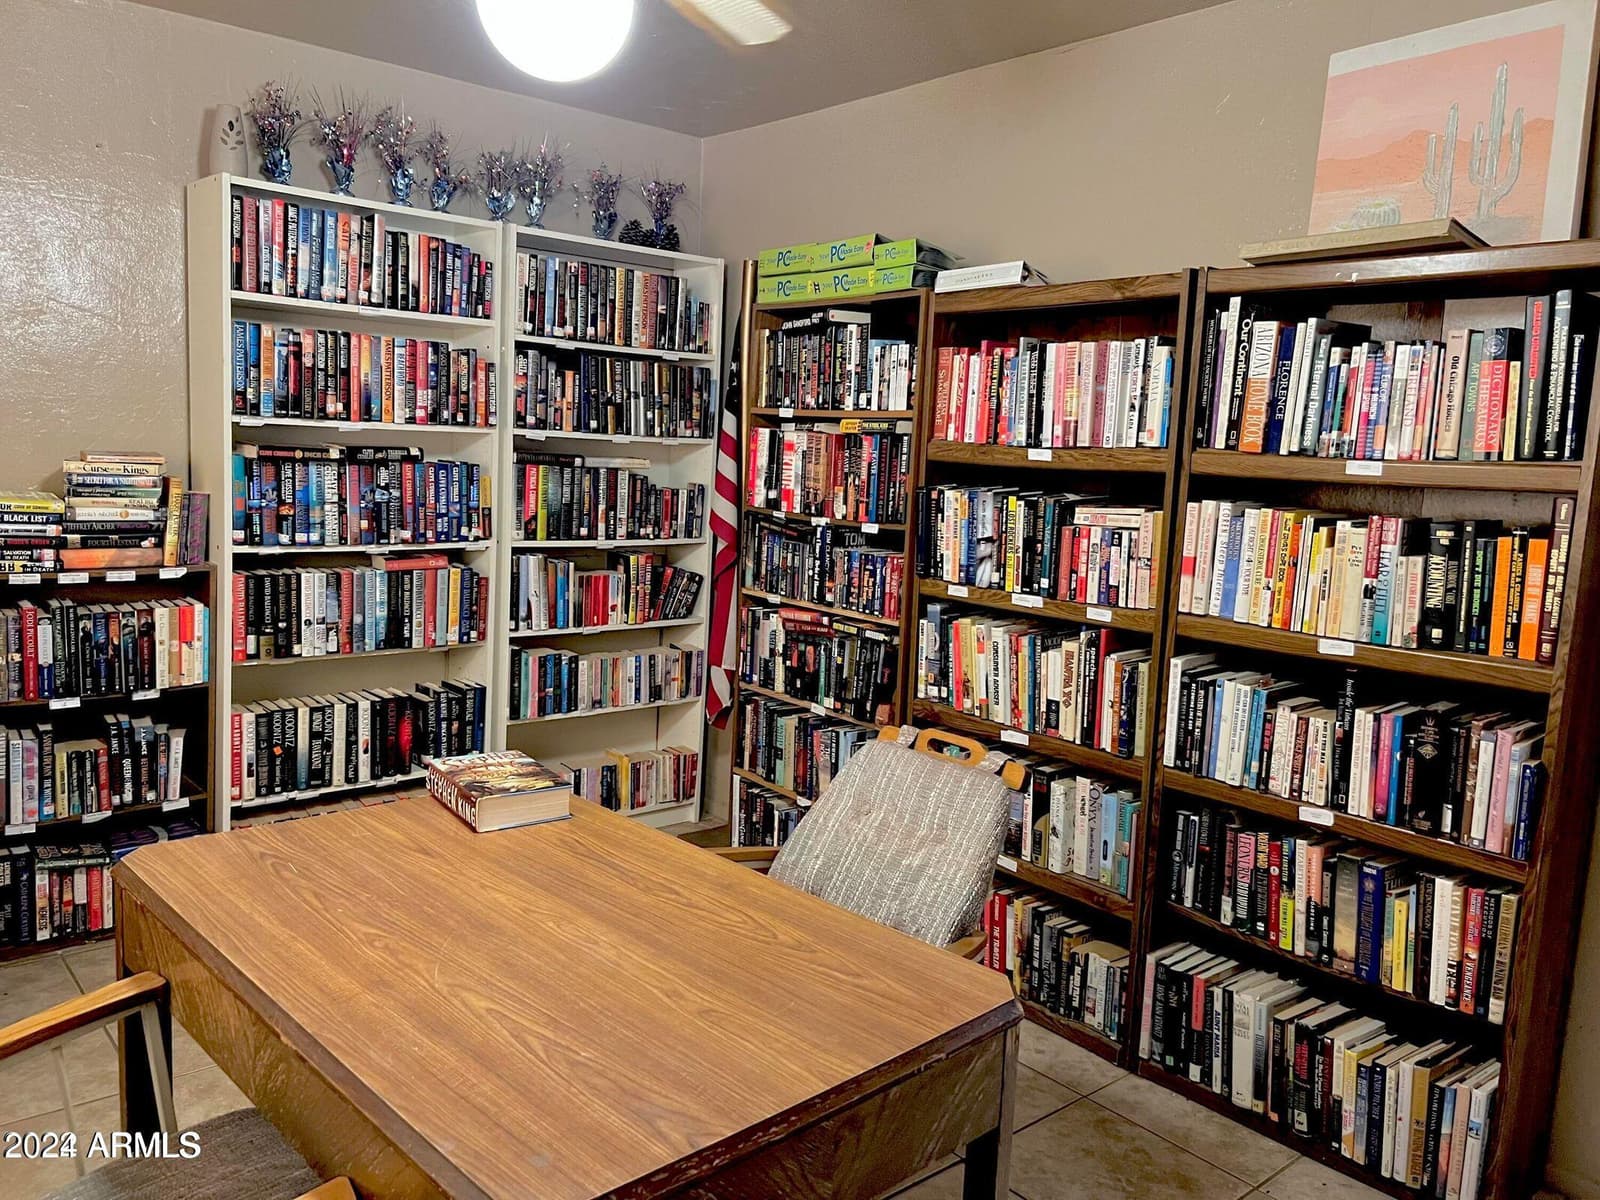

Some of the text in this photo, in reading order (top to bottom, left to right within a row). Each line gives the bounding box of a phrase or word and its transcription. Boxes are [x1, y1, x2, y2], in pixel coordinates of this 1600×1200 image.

[312, 238, 320, 254] Four
[777, 250, 791, 268] PC
[830, 243, 847, 263] PC
[885, 248, 896, 260] PC
[312, 254, 320, 269] Blind
[777, 280, 791, 297] PC
[833, 274, 850, 293] PC
[882, 273, 894, 285] PC
[1550, 317, 1561, 362] ACCOUNTING
[235, 325, 245, 392] JAMES PATTERSON
[384, 340, 392, 401] JAMES PATTERSON
[1030, 351, 1039, 369] Webb
[1234, 319, 1252, 397] Our Continent
[1451, 356, 1460, 369] Old
[935, 369, 947, 425] SHAKESPEARE
[1243, 327, 1272, 444] ARIZONA HOME BOOK
[1275, 360, 1291, 420] FLORENCE
[1379, 374, 1390, 402] EUROPE
[1447, 372, 1458, 403] Chicago
[1466, 363, 1480, 413] ART TOWNS
[1547, 371, 1557, 408] FINANCIAL
[1303, 365, 1325, 446] Eternal Darkness
[1368, 394, 1378, 420] MUNICH
[1402, 373, 1419, 428] IRELAND
[1475, 377, 1491, 449] THESAURUS
[1487, 365, 1504, 446] DICTIONARY
[1544, 410, 1555, 442] CONTROL
[83, 464, 110, 473] Curse
[123, 465, 149, 476] Kings
[439, 470, 447, 513] CLIVE CUSSLER
[4, 514, 47, 523] BLACK LIST
[844, 532, 866, 546] TOM
[1007, 527, 1015, 553] ROCKERS
[1233, 520, 1242, 560] ALCOHOLICS
[1247, 537, 1255, 553] RIGHT
[1559, 534, 1569, 562] HANDBOOK
[1214, 508, 1231, 601] COREN Sleep Thieves
[1254, 535, 1267, 586] CHOLESTEROL CURE
[1474, 550, 1484, 572] DON'T
[1516, 553, 1524, 576] PANICS
[1550, 549, 1558, 572] REPORTS
[1243, 568, 1251, 582] YOUR
[1375, 551, 1392, 615] FEAR FIFTY
[1426, 554, 1445, 608] ACCOUNTING
[1445, 561, 1459, 605] HANDBOOK COST
[1473, 574, 1482, 587] DIE
[1529, 565, 1543, 585] LORDS
[1555, 575, 1564, 593] MODEL
[1241, 584, 1249, 596] TYPE
[1513, 584, 1521, 611] CRASHES
[1529, 587, 1541, 595] OF
[1544, 588, 1555, 612] FORMATS
[1511, 612, 1519, 623] and
[1550, 597, 1562, 629] ACCOUNTING
[26, 611, 35, 657] JODI PICOULT
[992, 641, 1000, 677] CONSUMER
[1089, 648, 1097, 680] speeches
[1346, 679, 1355, 696] Inside
[111, 738, 119, 754] JANCE
[123, 759, 131, 778] QUEEN
[425, 768, 476, 827] STEPHEN KING
[1088, 788, 1101, 823] ONYX
[1238, 836, 1251, 881] LEON URIS
[1236, 882, 1248, 919] REDEMPTION
[39, 907, 47, 931] NEMESIS
[1481, 896, 1490, 938] EXECUTION
[992, 938, 1000, 969] TRAVELER
[1462, 962, 1475, 1002] VENGEANCE
[1213, 1033, 1221, 1058] MARIA
